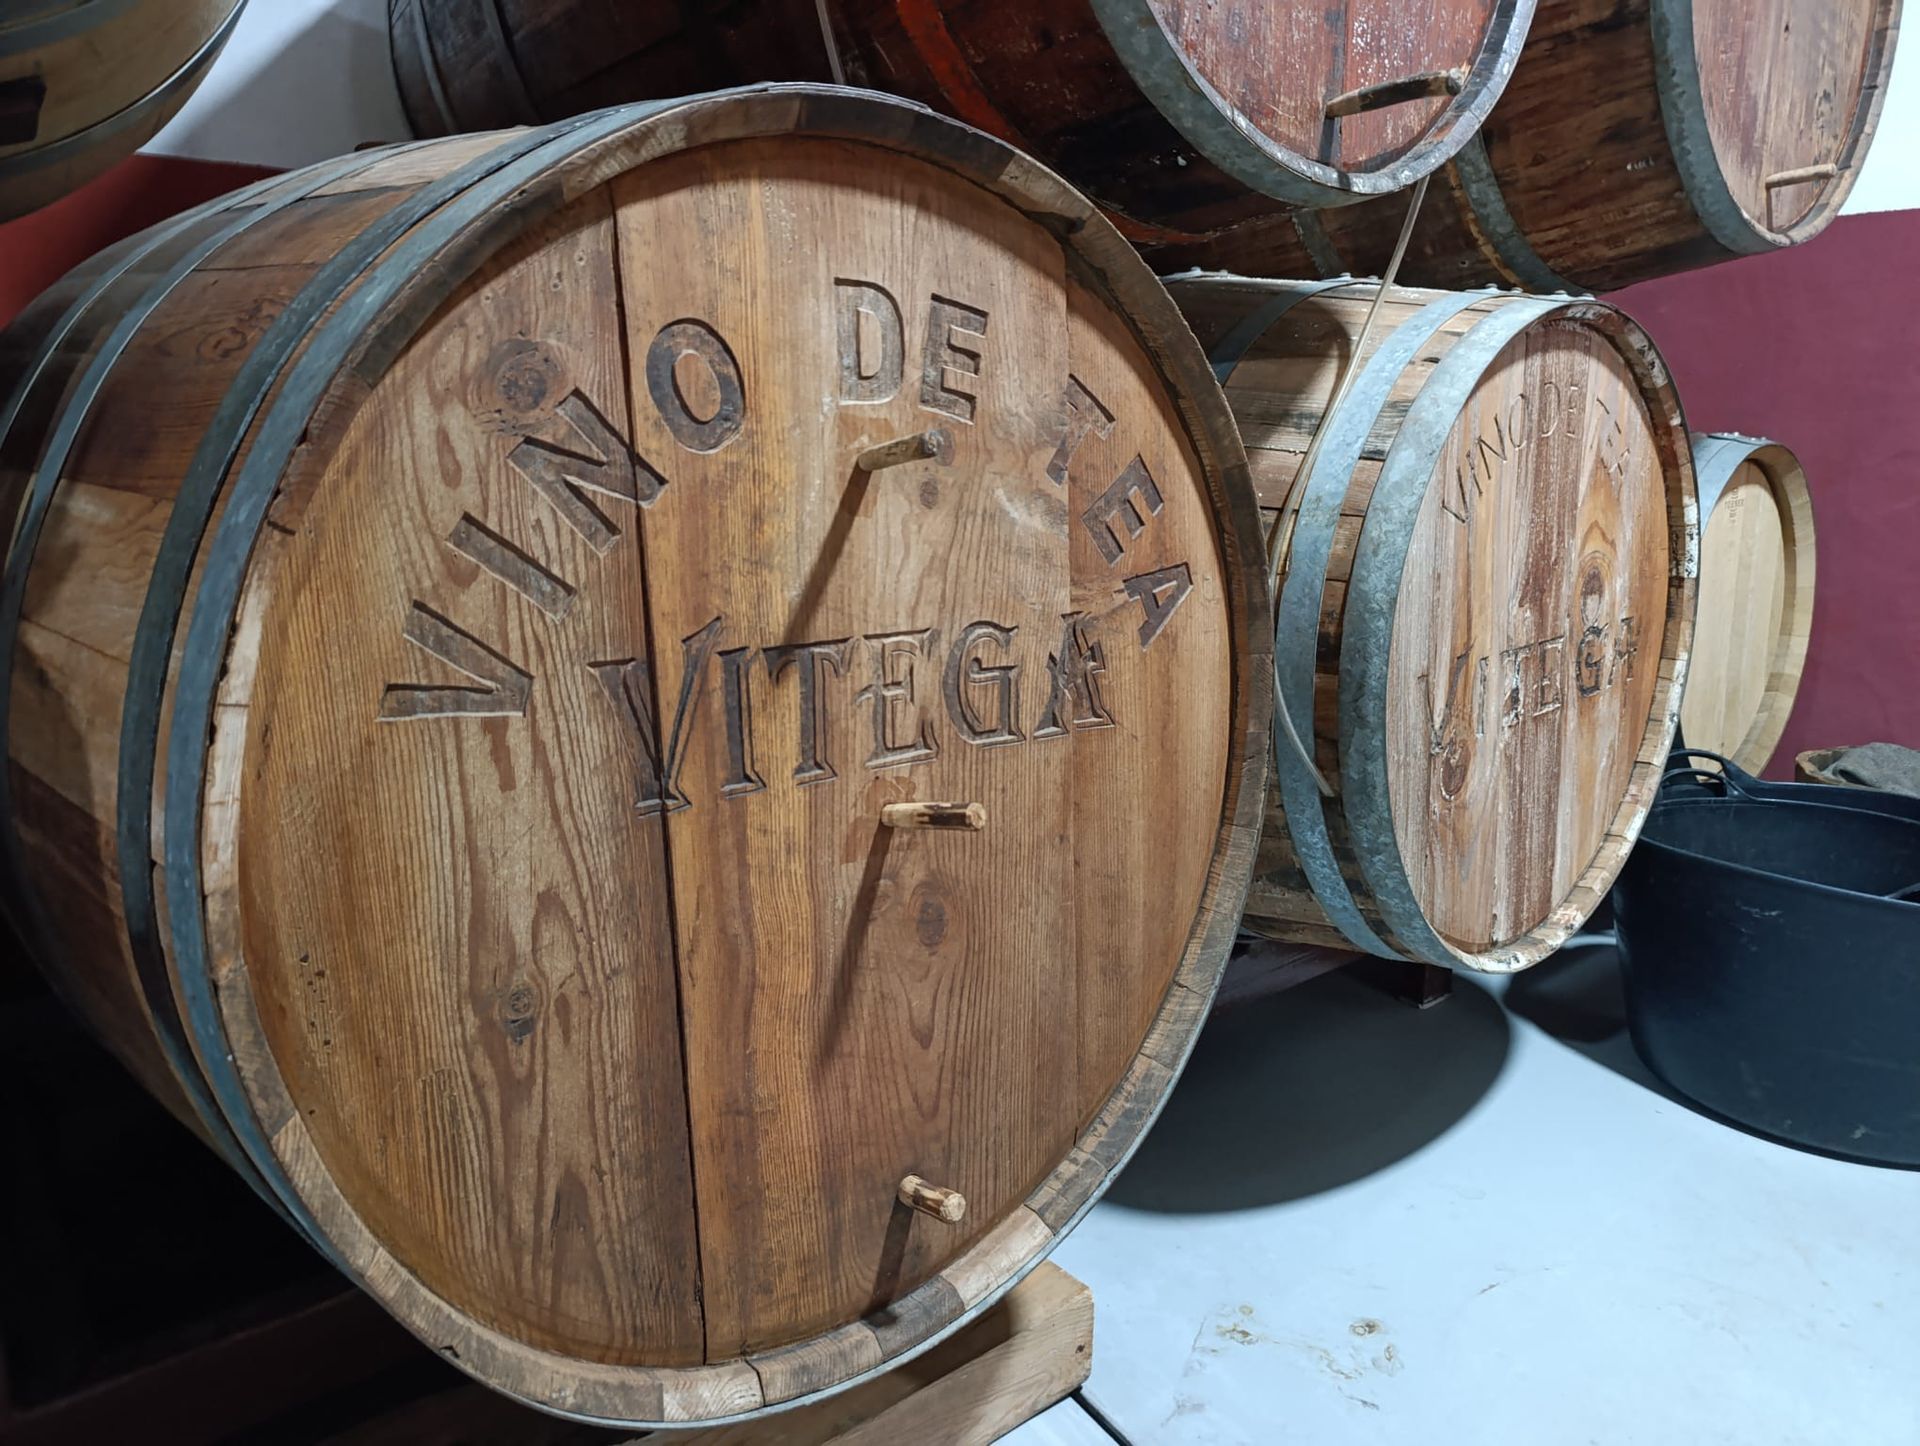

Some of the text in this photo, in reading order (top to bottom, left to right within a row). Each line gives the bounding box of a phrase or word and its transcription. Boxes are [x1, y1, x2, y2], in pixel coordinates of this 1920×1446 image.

[376, 276, 1196, 723] VINO DE TEA
[588, 610, 1117, 818] VITEGA
